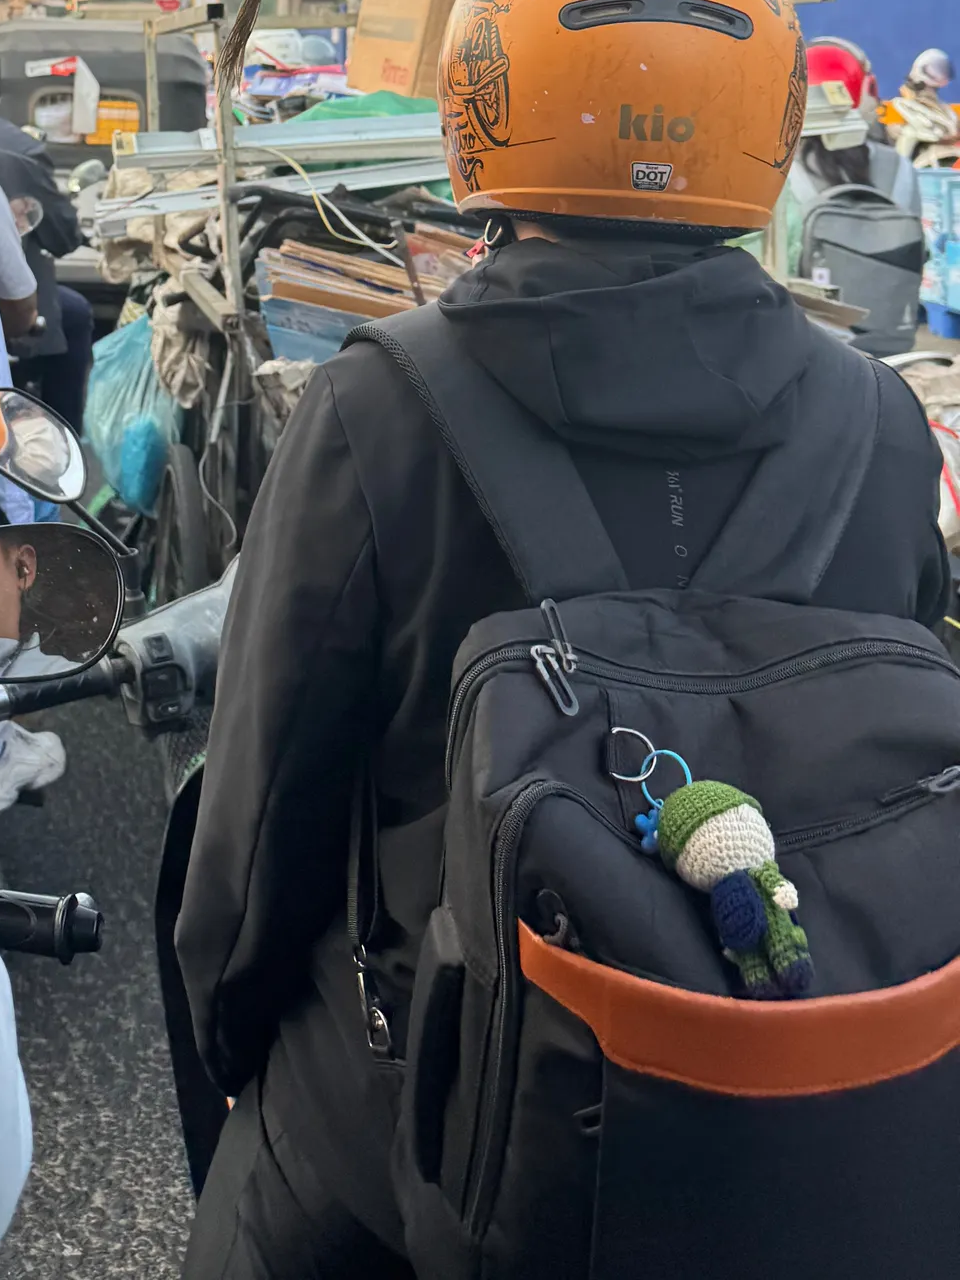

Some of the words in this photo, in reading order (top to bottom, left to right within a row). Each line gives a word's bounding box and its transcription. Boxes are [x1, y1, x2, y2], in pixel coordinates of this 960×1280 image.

[618, 104, 695, 143] kio
[635, 170, 667, 182] DOT
[670, 494, 684, 527] RUN
